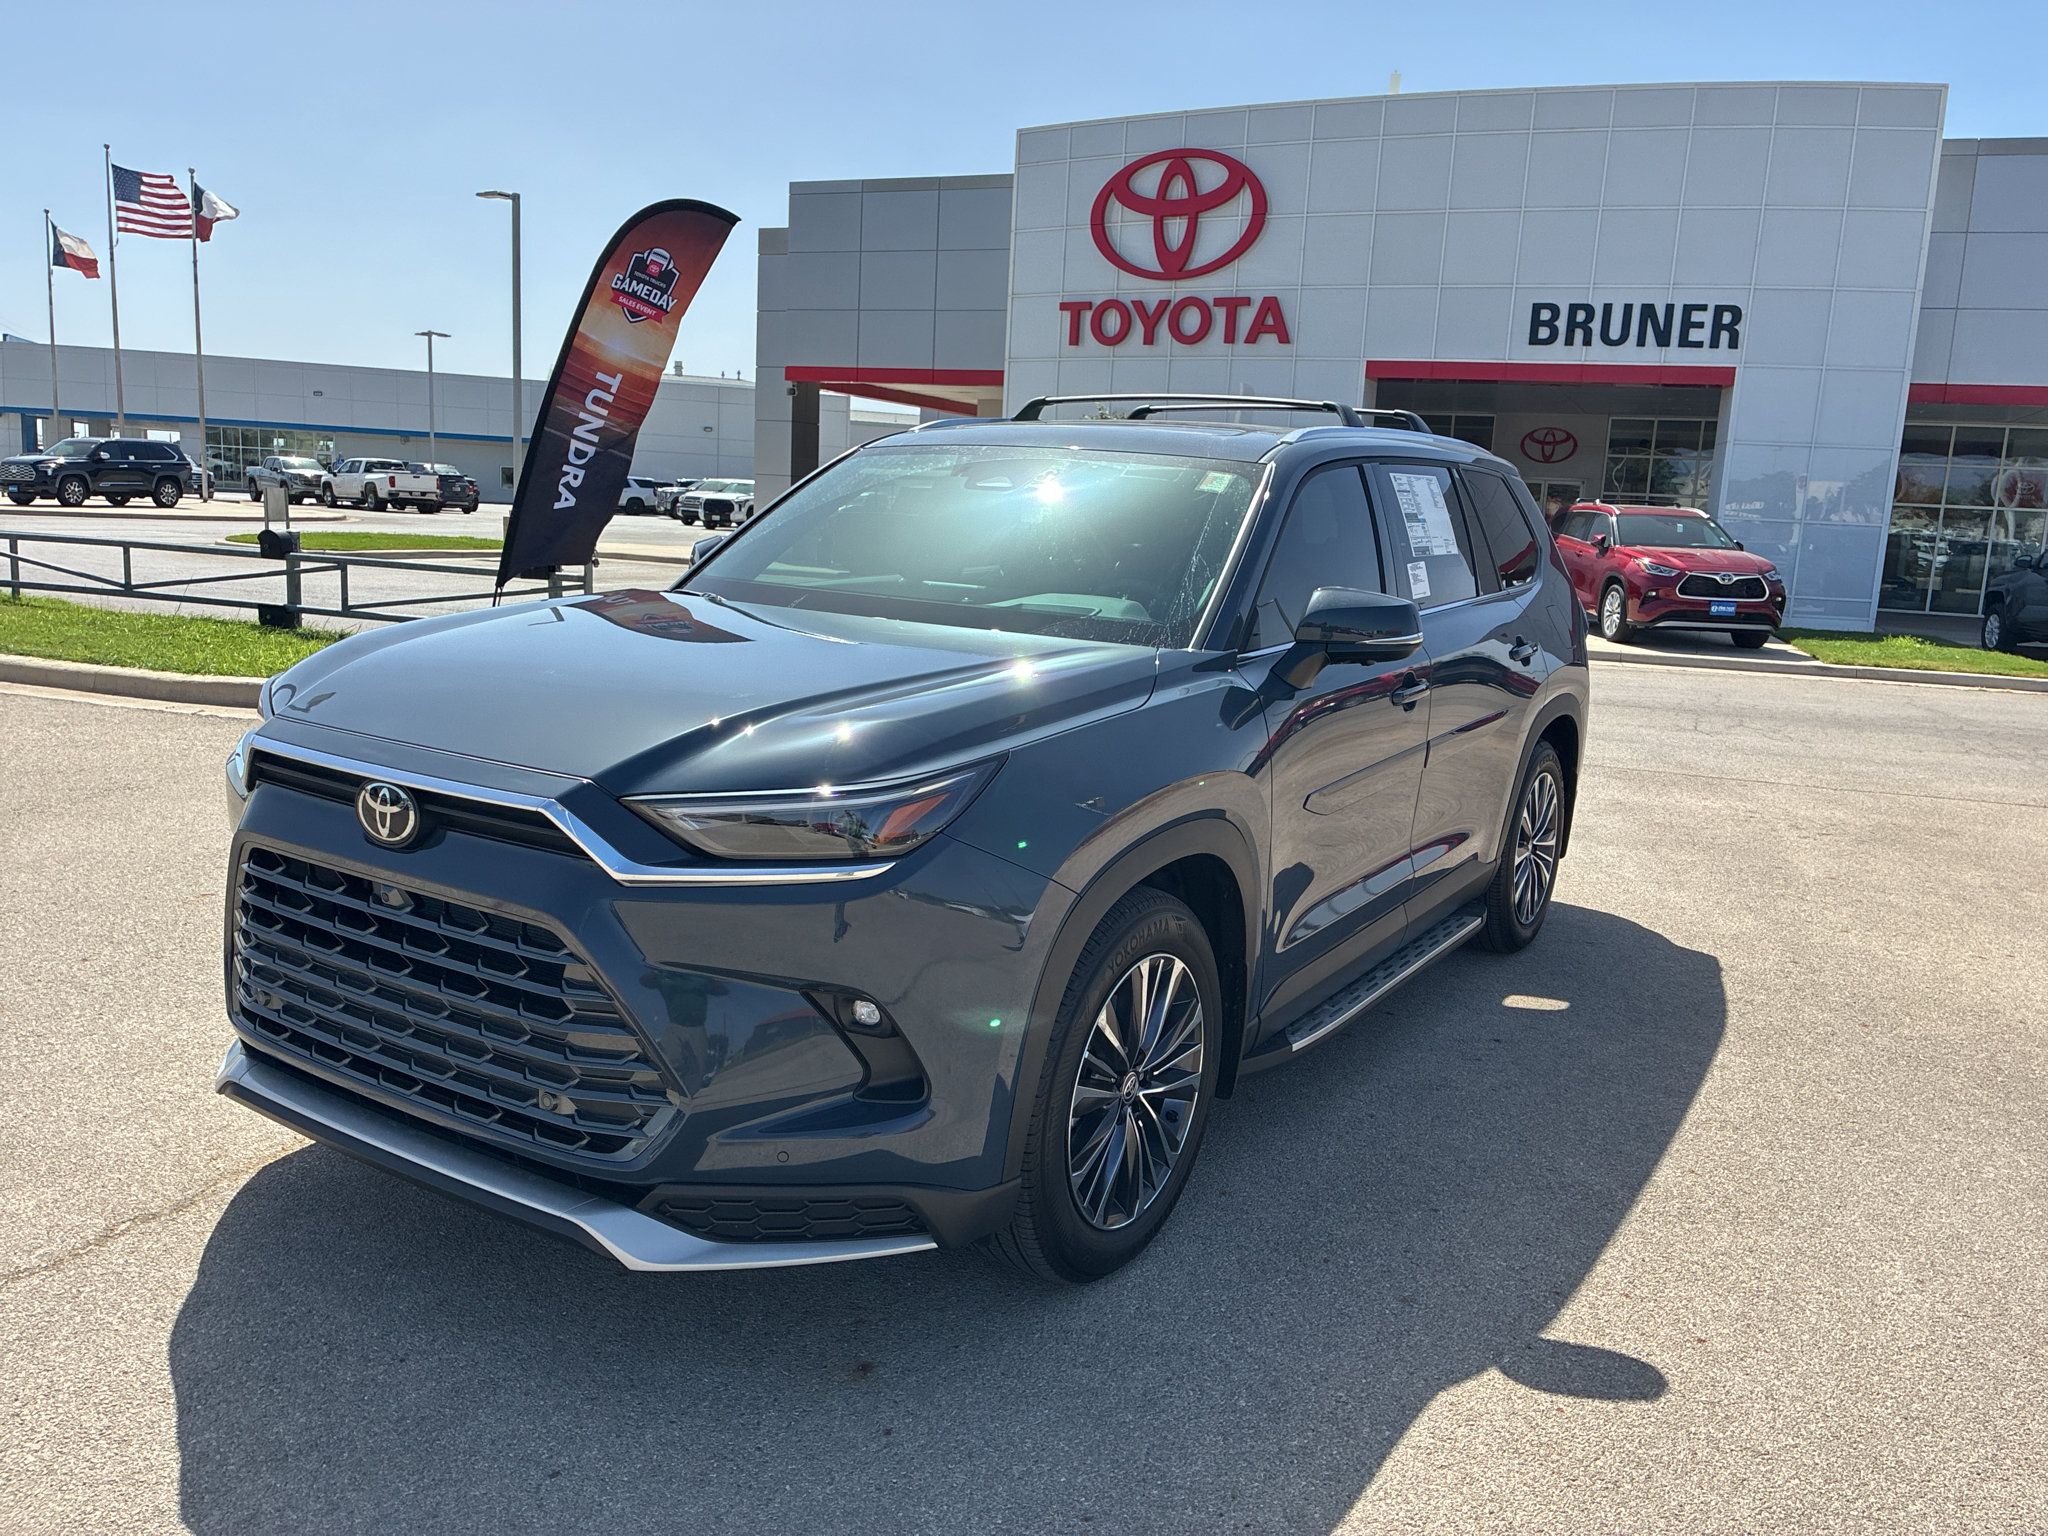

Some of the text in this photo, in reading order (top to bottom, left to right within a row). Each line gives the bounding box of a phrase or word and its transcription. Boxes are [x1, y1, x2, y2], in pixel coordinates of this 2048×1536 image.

[611, 273, 678, 312] GAMEDAY
[618, 296, 657, 316] SALES EVENT
[1059, 296, 1291, 346] TOYOTA
[1528, 302, 1743, 350] BRUNER
[553, 371, 623, 510] TUNDRA
[1108, 915, 1171, 975] YOKOHAMA
